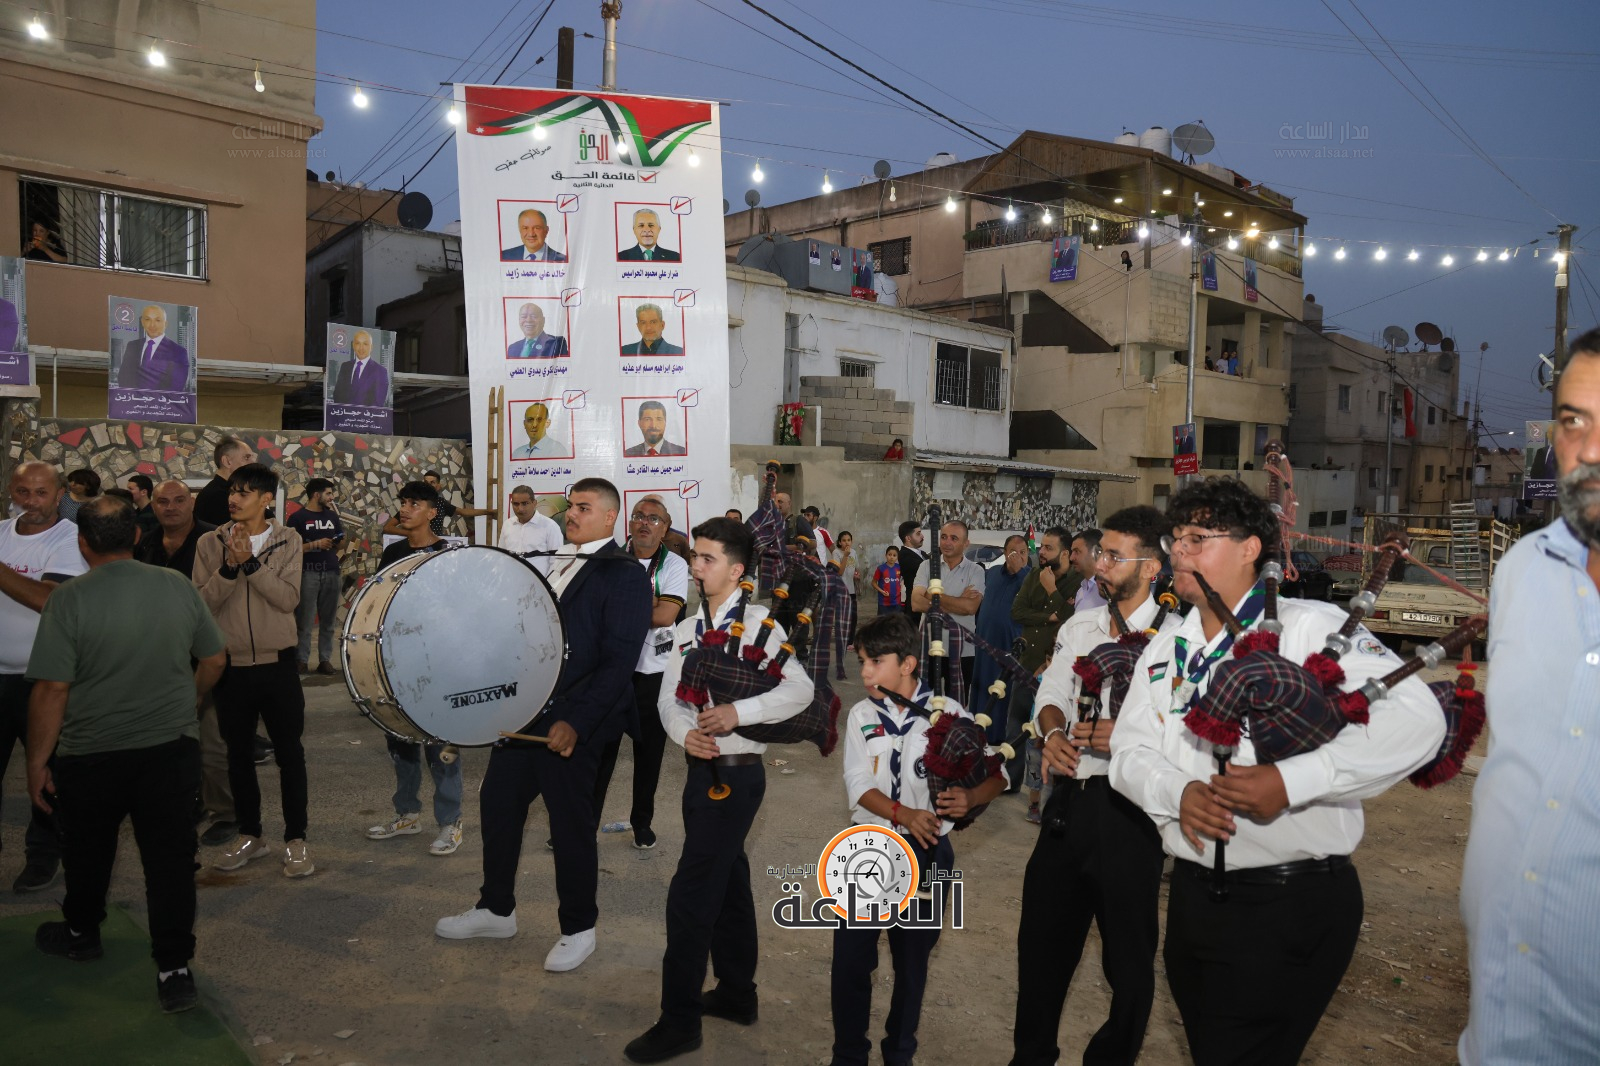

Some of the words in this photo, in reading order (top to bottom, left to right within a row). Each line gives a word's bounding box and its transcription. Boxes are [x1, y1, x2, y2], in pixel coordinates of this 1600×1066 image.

[602, 172, 636, 181] قائمة
[520, 269, 537, 277] محمد
[539, 269, 550, 280] علي
[551, 269, 565, 278] خالد
[121, 309, 130, 322] 2
[337, 334, 344, 345] 2
[114, 393, 155, 403] حجازين
[1533, 428, 1540, 437] 2
[305, 519, 335, 530] FILA
[450, 682, 518, 708] MAXTONE
